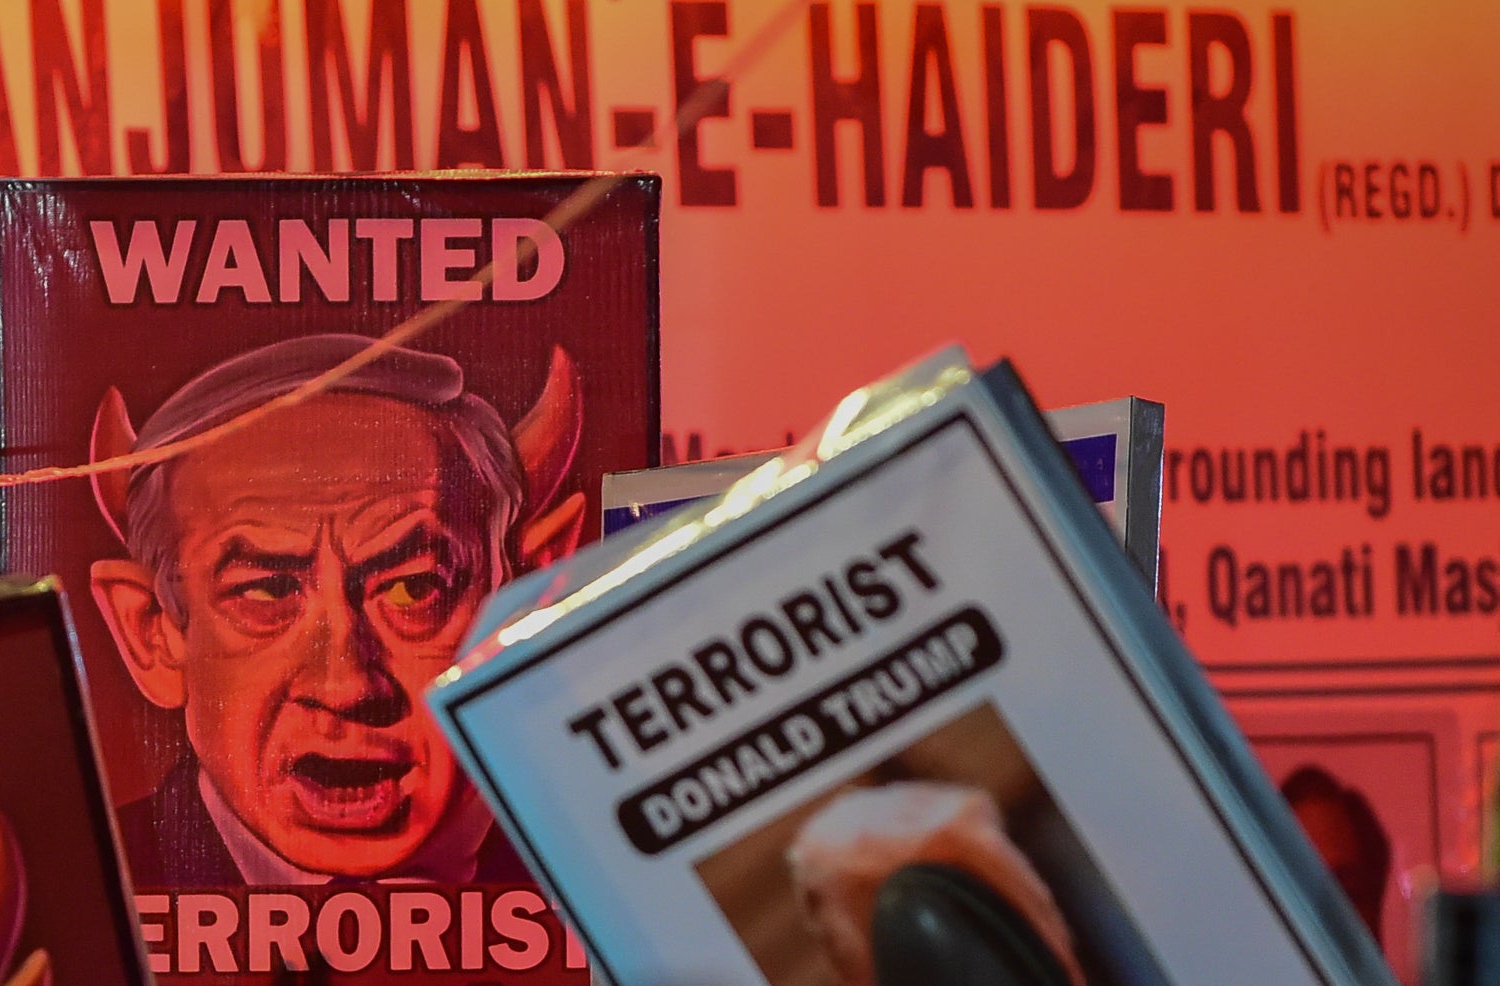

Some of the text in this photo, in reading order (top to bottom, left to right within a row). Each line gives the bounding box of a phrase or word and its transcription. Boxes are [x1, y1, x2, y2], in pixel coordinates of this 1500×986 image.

[1317, 162, 1472, 233] (REGD.)
[89, 217, 566, 305] WANTED
[1206, 543, 1376, 629] Qanati
[569, 531, 940, 769] TERRORIST
[641, 620, 980, 840] DONALD TRUMP
